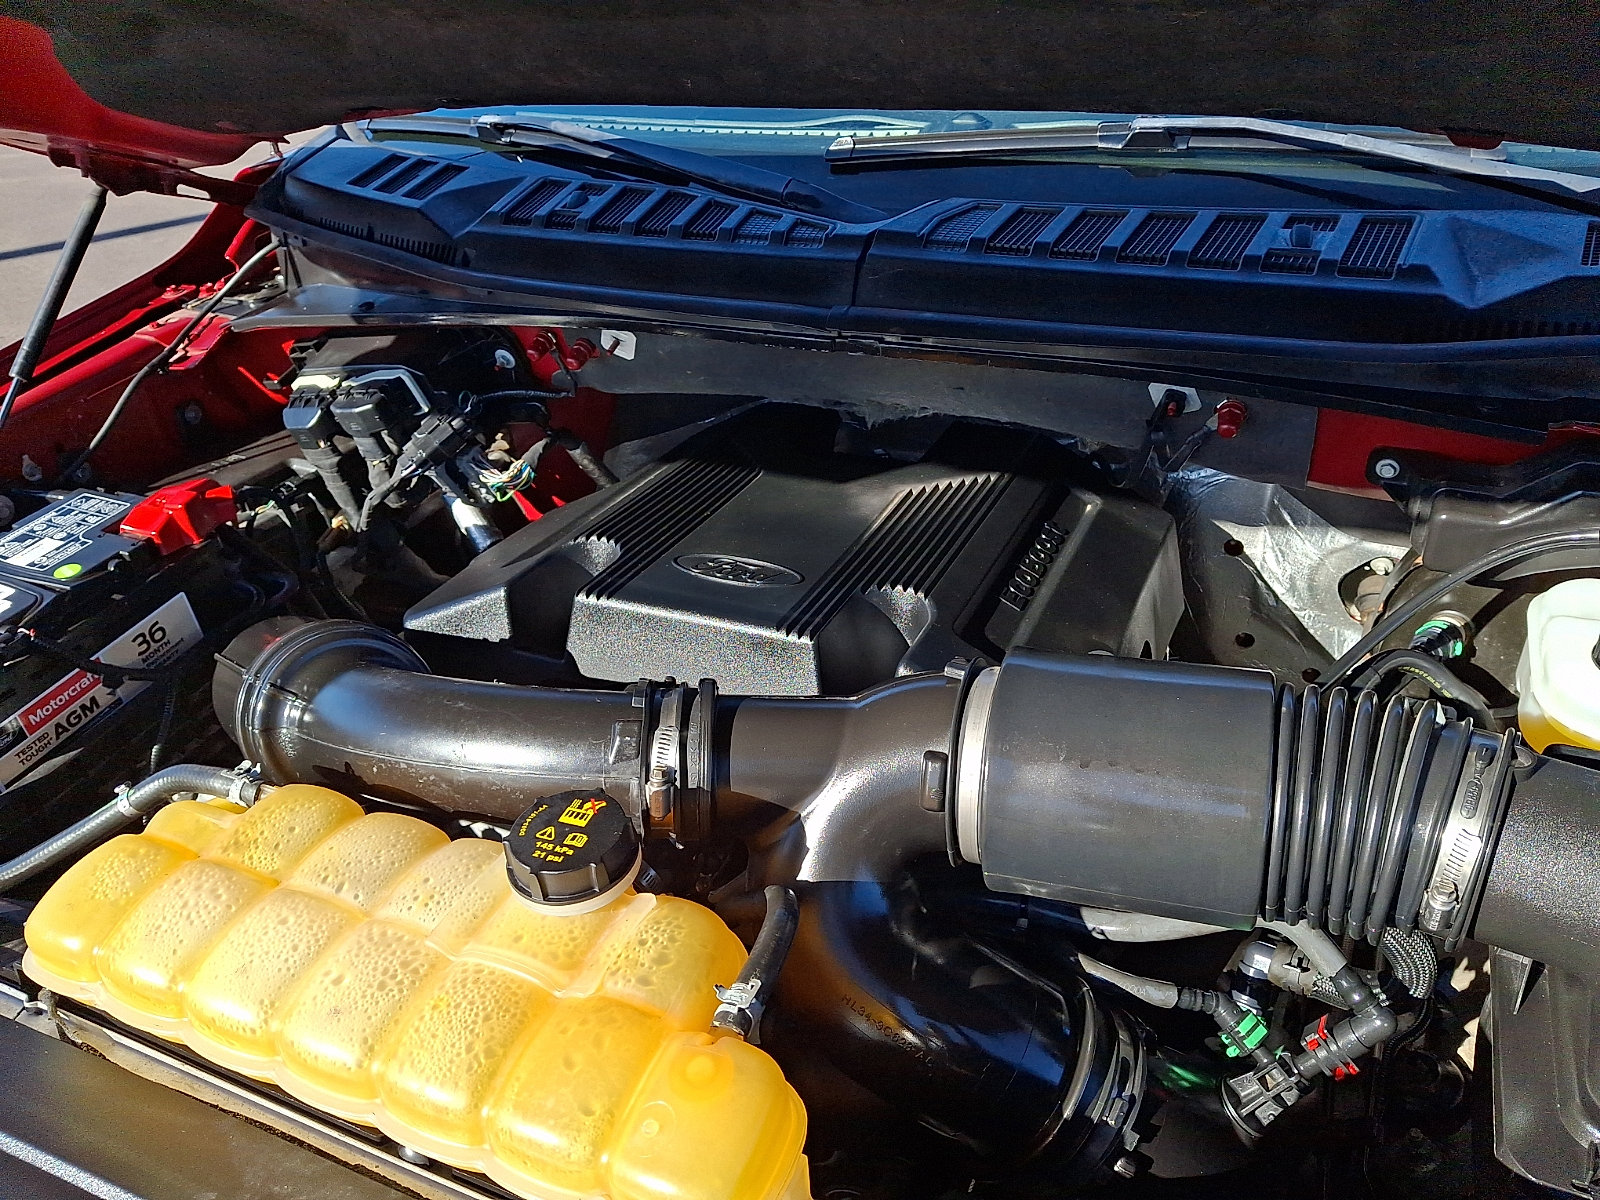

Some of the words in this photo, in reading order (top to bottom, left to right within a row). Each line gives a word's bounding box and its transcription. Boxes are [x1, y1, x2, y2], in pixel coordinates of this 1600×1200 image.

[690, 558, 784, 584] Ford
[131, 620, 167, 656] 36
[141, 639, 171, 664] MONTH
[54, 695, 100, 740] AGM
[14, 731, 50, 759] TESTED
[535, 841, 554, 850] 145
[554, 845, 574, 855] kPa
